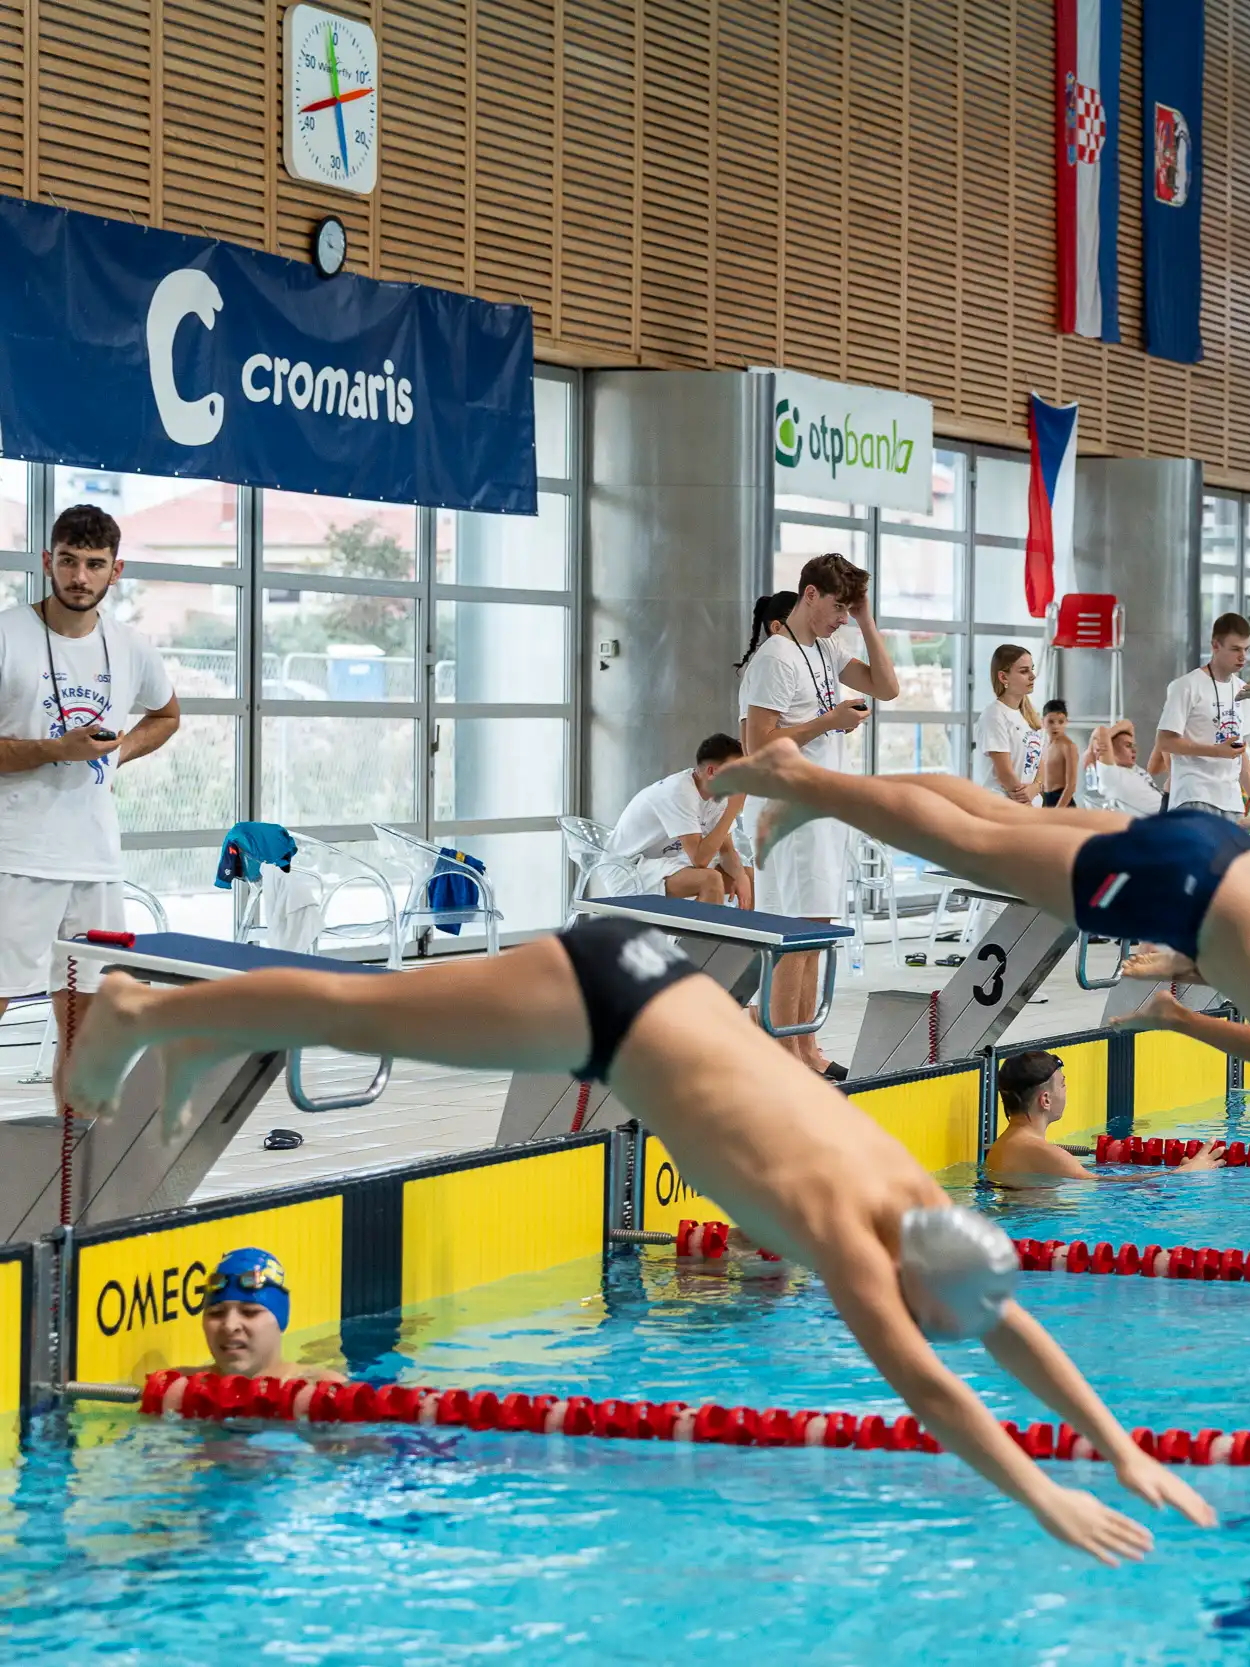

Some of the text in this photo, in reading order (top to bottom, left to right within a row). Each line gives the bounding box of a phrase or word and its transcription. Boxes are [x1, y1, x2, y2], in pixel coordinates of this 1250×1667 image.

[304, 55, 316, 69] 50
[355, 70, 366, 84] 10
[304, 116, 315, 131] 40
[355, 130, 366, 145] 20
[330, 155, 341, 169] 30
[241, 353, 414, 425] cromaris
[973, 944, 1007, 1006] 3
[96, 1261, 206, 1336] OMEG
